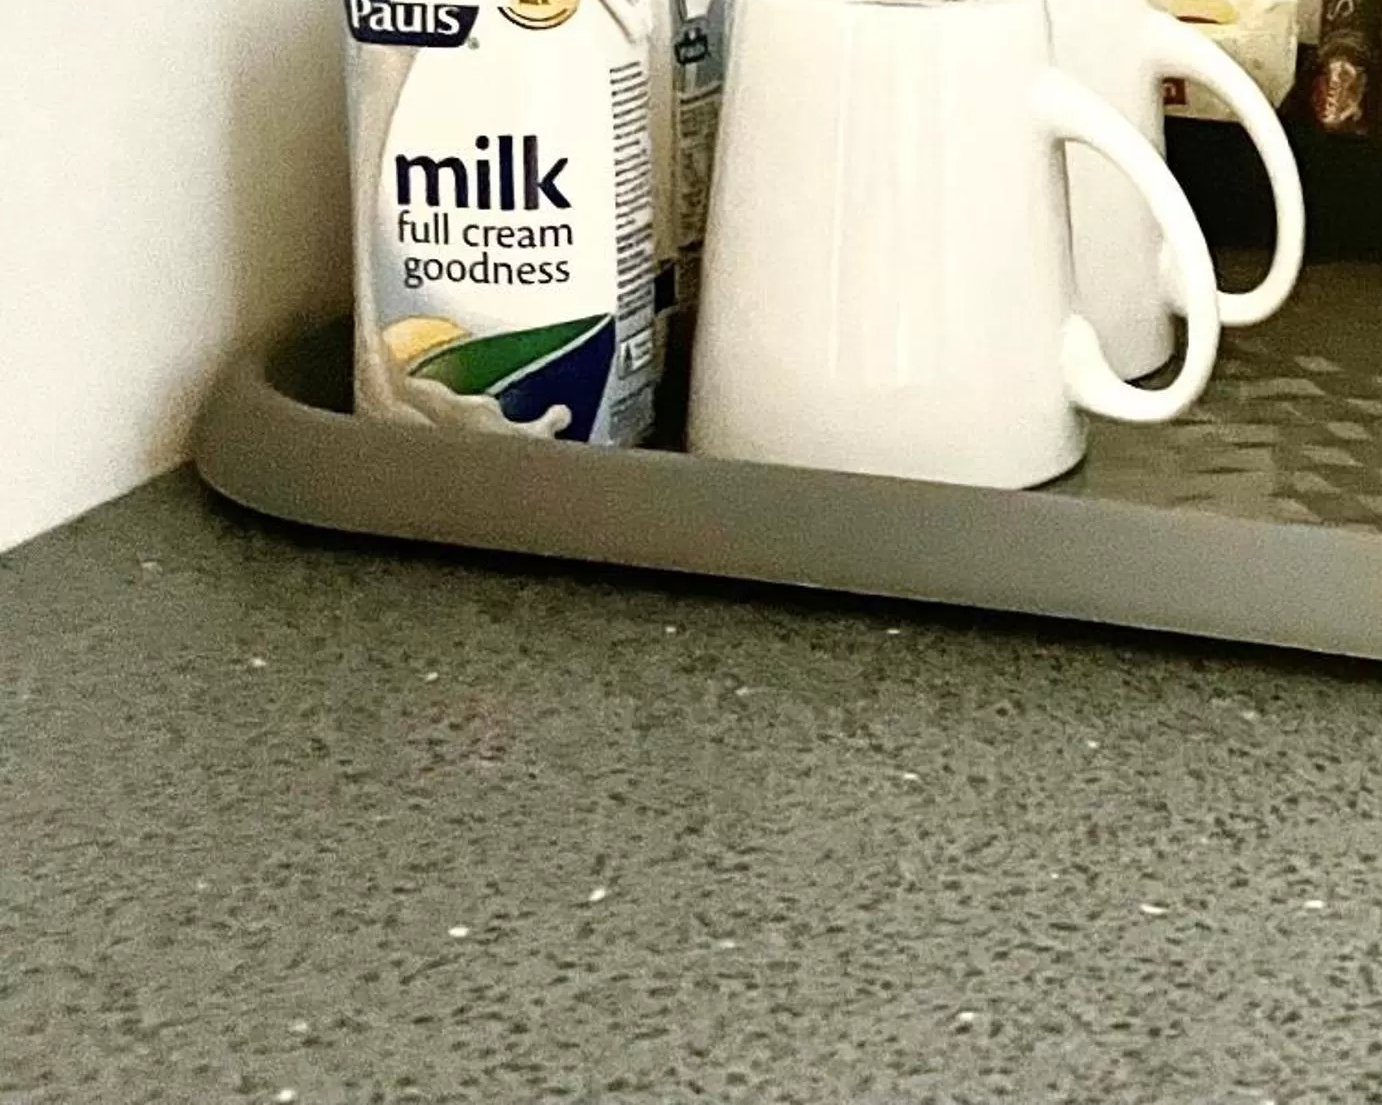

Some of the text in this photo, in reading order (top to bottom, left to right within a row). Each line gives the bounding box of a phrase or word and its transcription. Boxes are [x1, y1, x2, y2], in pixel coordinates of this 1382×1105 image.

[394, 134, 572, 211] milk
[397, 209, 573, 249] full cream
[404, 251, 571, 289] goodness
